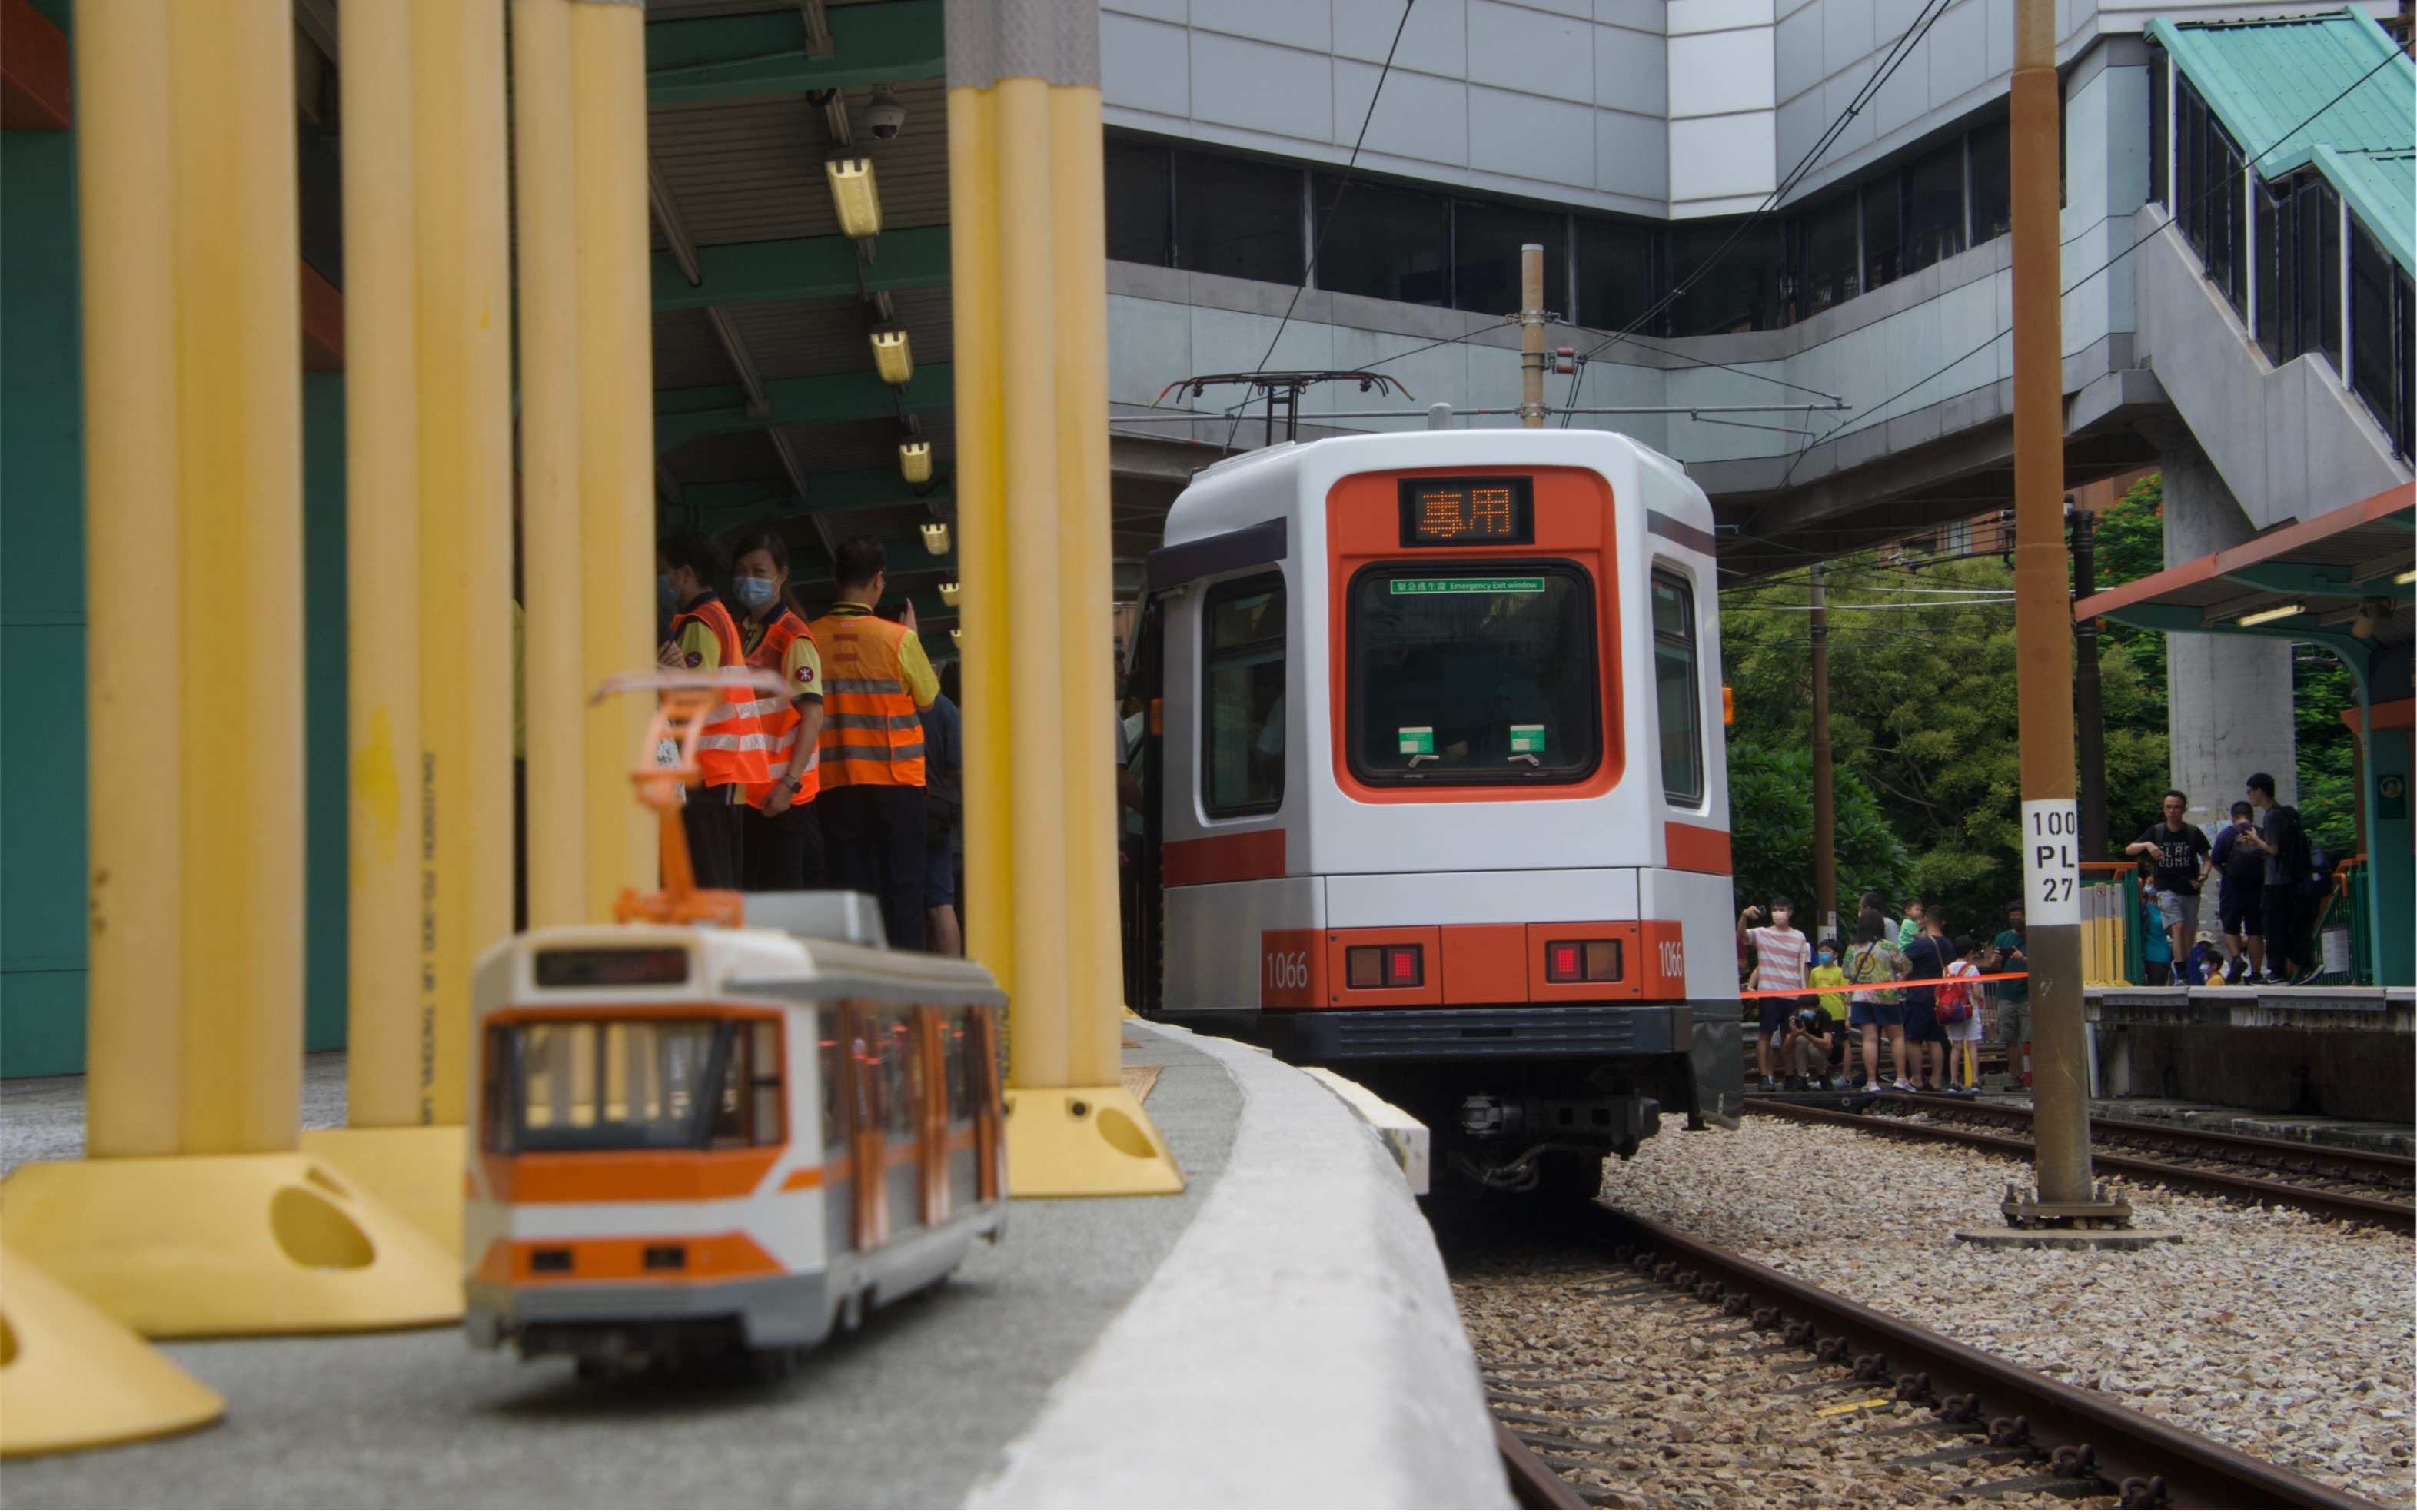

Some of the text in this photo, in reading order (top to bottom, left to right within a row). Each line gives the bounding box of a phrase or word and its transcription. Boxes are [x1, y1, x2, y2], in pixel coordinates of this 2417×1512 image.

[1420, 489, 1509, 537] 專用
[2033, 811, 2075, 836] 100
[2036, 845, 2075, 869] PL
[2043, 878, 2073, 902] 27
[1267, 951, 1307, 989] 1066
[1659, 941, 1683, 977] 1066
